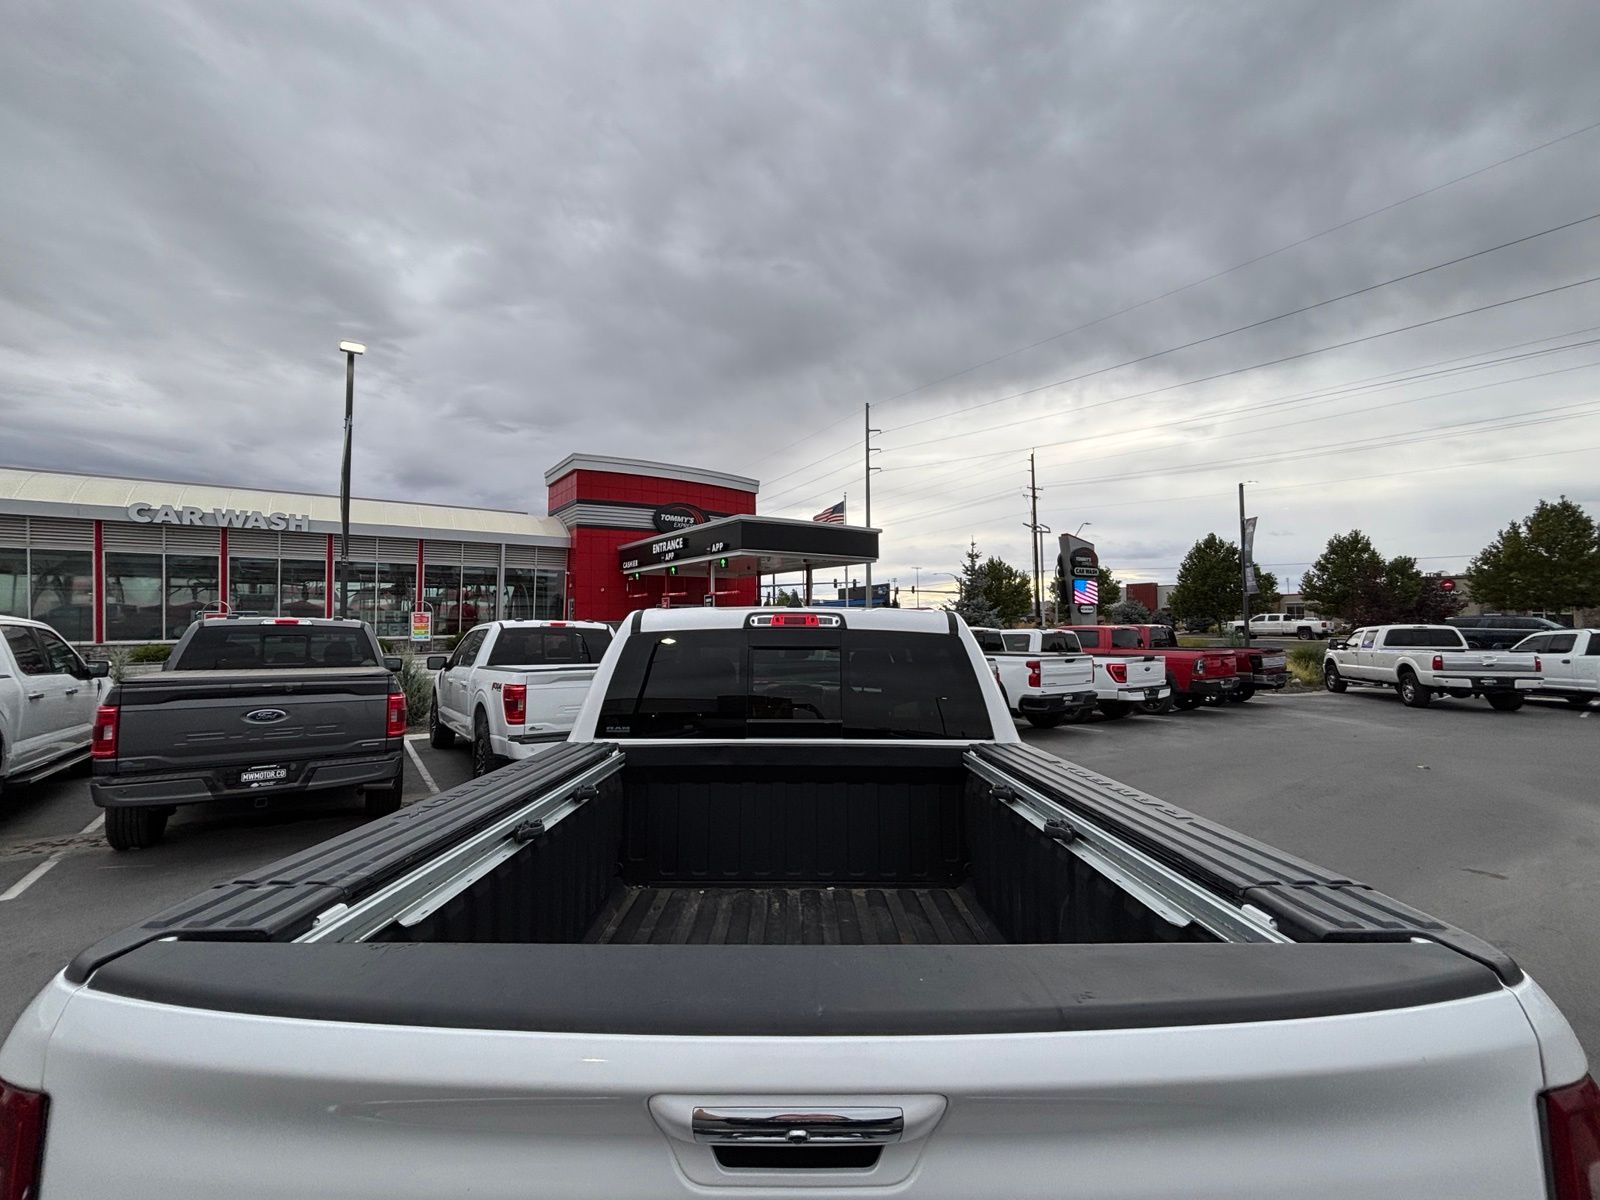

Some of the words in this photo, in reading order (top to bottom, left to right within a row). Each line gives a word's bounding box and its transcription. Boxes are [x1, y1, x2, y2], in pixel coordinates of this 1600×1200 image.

[127, 502, 203, 525] CAR
[213, 508, 309, 532] WASH
[661, 514, 695, 523] TOMMY'S
[653, 538, 683, 553] ENTRANCE
[711, 543, 723, 552] APP
